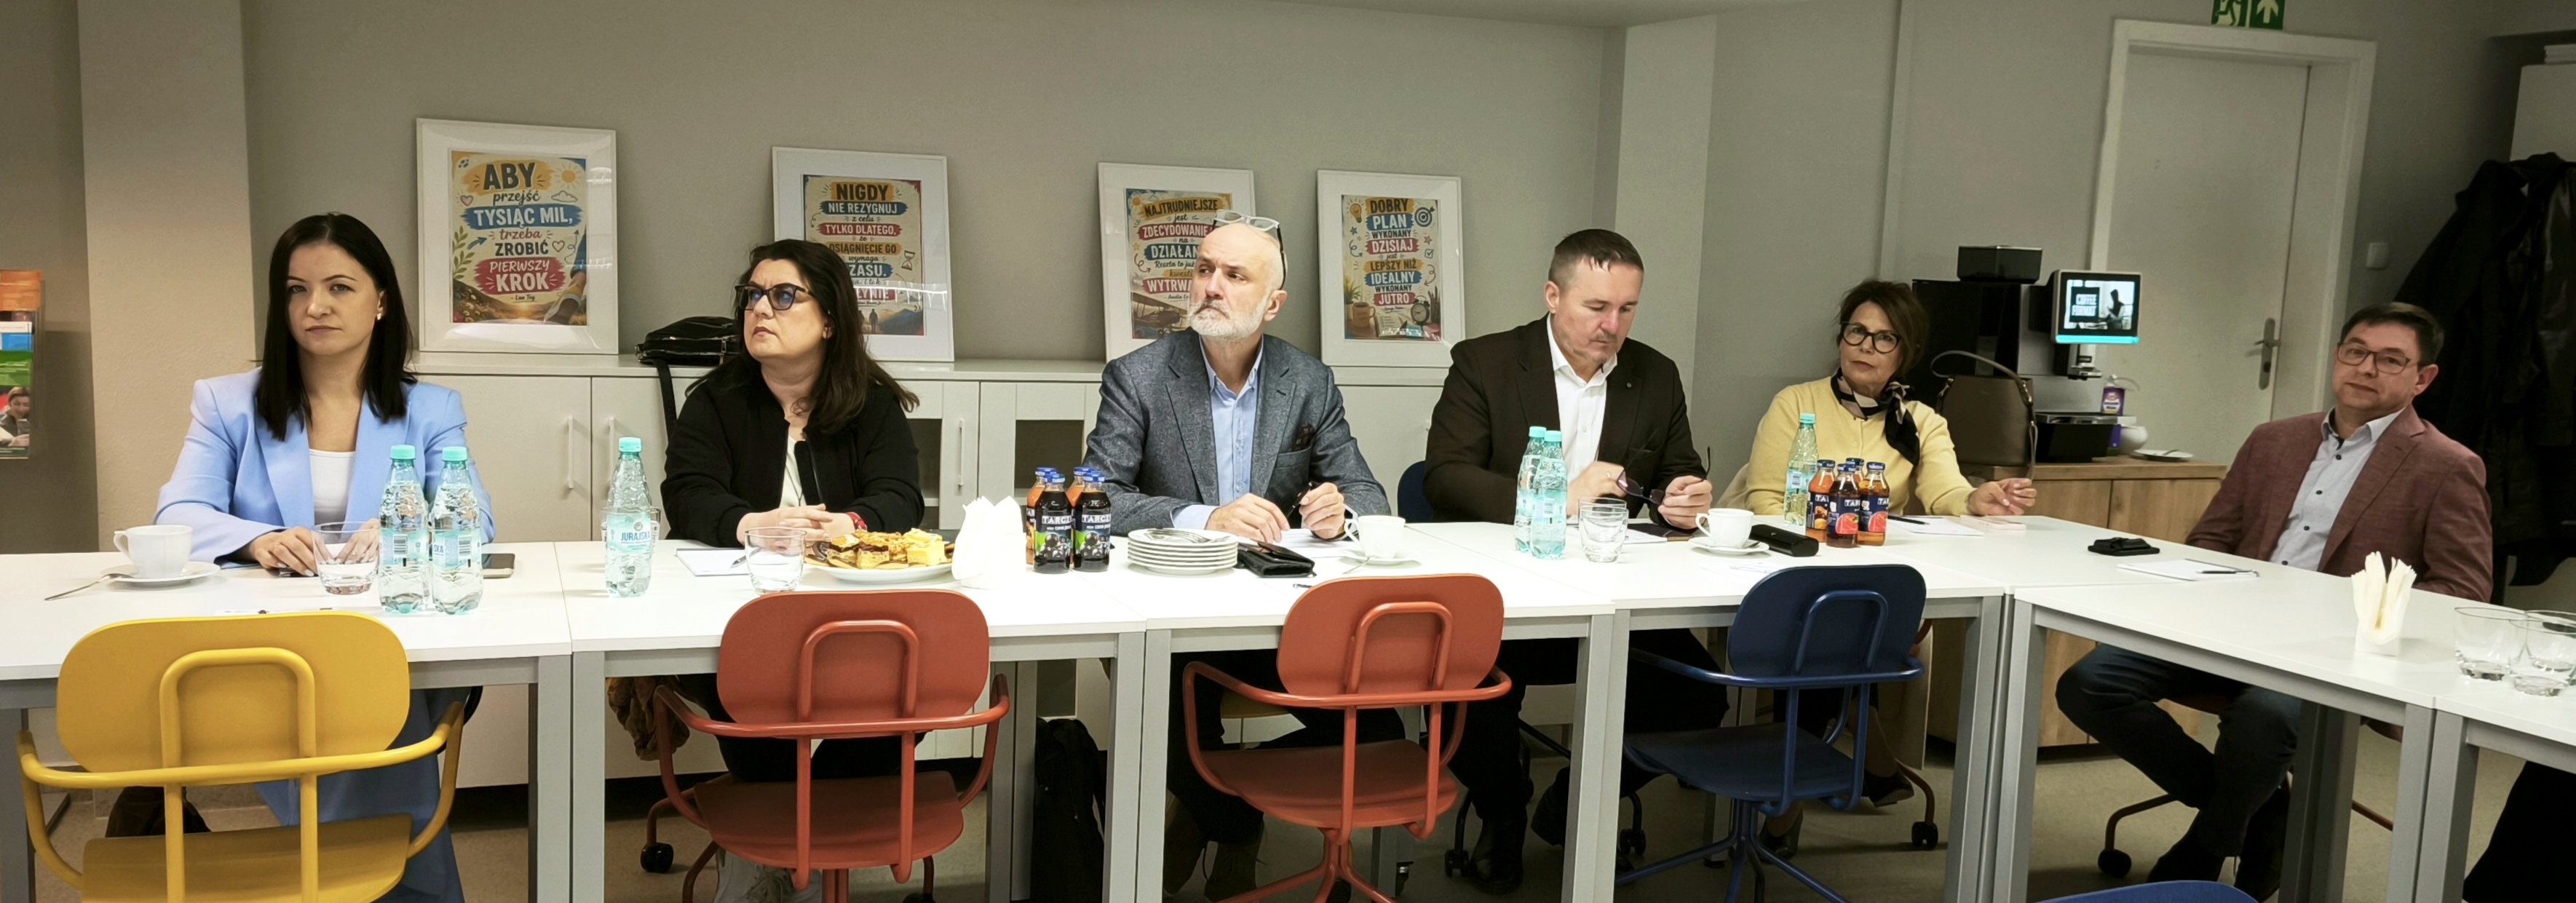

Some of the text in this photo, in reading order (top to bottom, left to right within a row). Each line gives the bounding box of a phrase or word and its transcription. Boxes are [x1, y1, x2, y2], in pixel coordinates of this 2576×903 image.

[483, 162, 536, 191] ABY
[492, 189, 541, 207] przejść
[836, 183, 889, 202] NIGDY
[828, 202, 897, 214] NIE REZYGNUJ
[1144, 199, 1218, 217] NAJTRUDNIEJSZE
[1370, 199, 1408, 213] DOBRY
[474, 207, 573, 228] TYSIĄC MIL,
[858, 215, 875, 223] celu
[1173, 213, 1189, 223] jest
[1373, 215, 1407, 229] PLAN
[499, 227, 542, 239] trzeba
[825, 224, 853, 234] TYLKO
[1142, 224, 1208, 238] ZDECYDOWANIE
[1371, 229, 1411, 239] WYKONANY
[494, 239, 549, 257] ZROBIĆ
[829, 243, 897, 255] OSIĄGNIĘCIE GO
[1372, 239, 1414, 253] DZISIAJ
[489, 259, 550, 274] PIERWSZY
[849, 264, 887, 277] ZASU.
[1184, 260, 1195, 270] już
[1371, 258, 1416, 271] LEPSZY NIŻ
[496, 272, 550, 292] KROK
[1371, 271, 1414, 285] IDEALNY
[856, 288, 889, 299] ŁYNIE
[1375, 285, 1412, 293] WYKONANY
[1379, 293, 1409, 305] JUTRO
